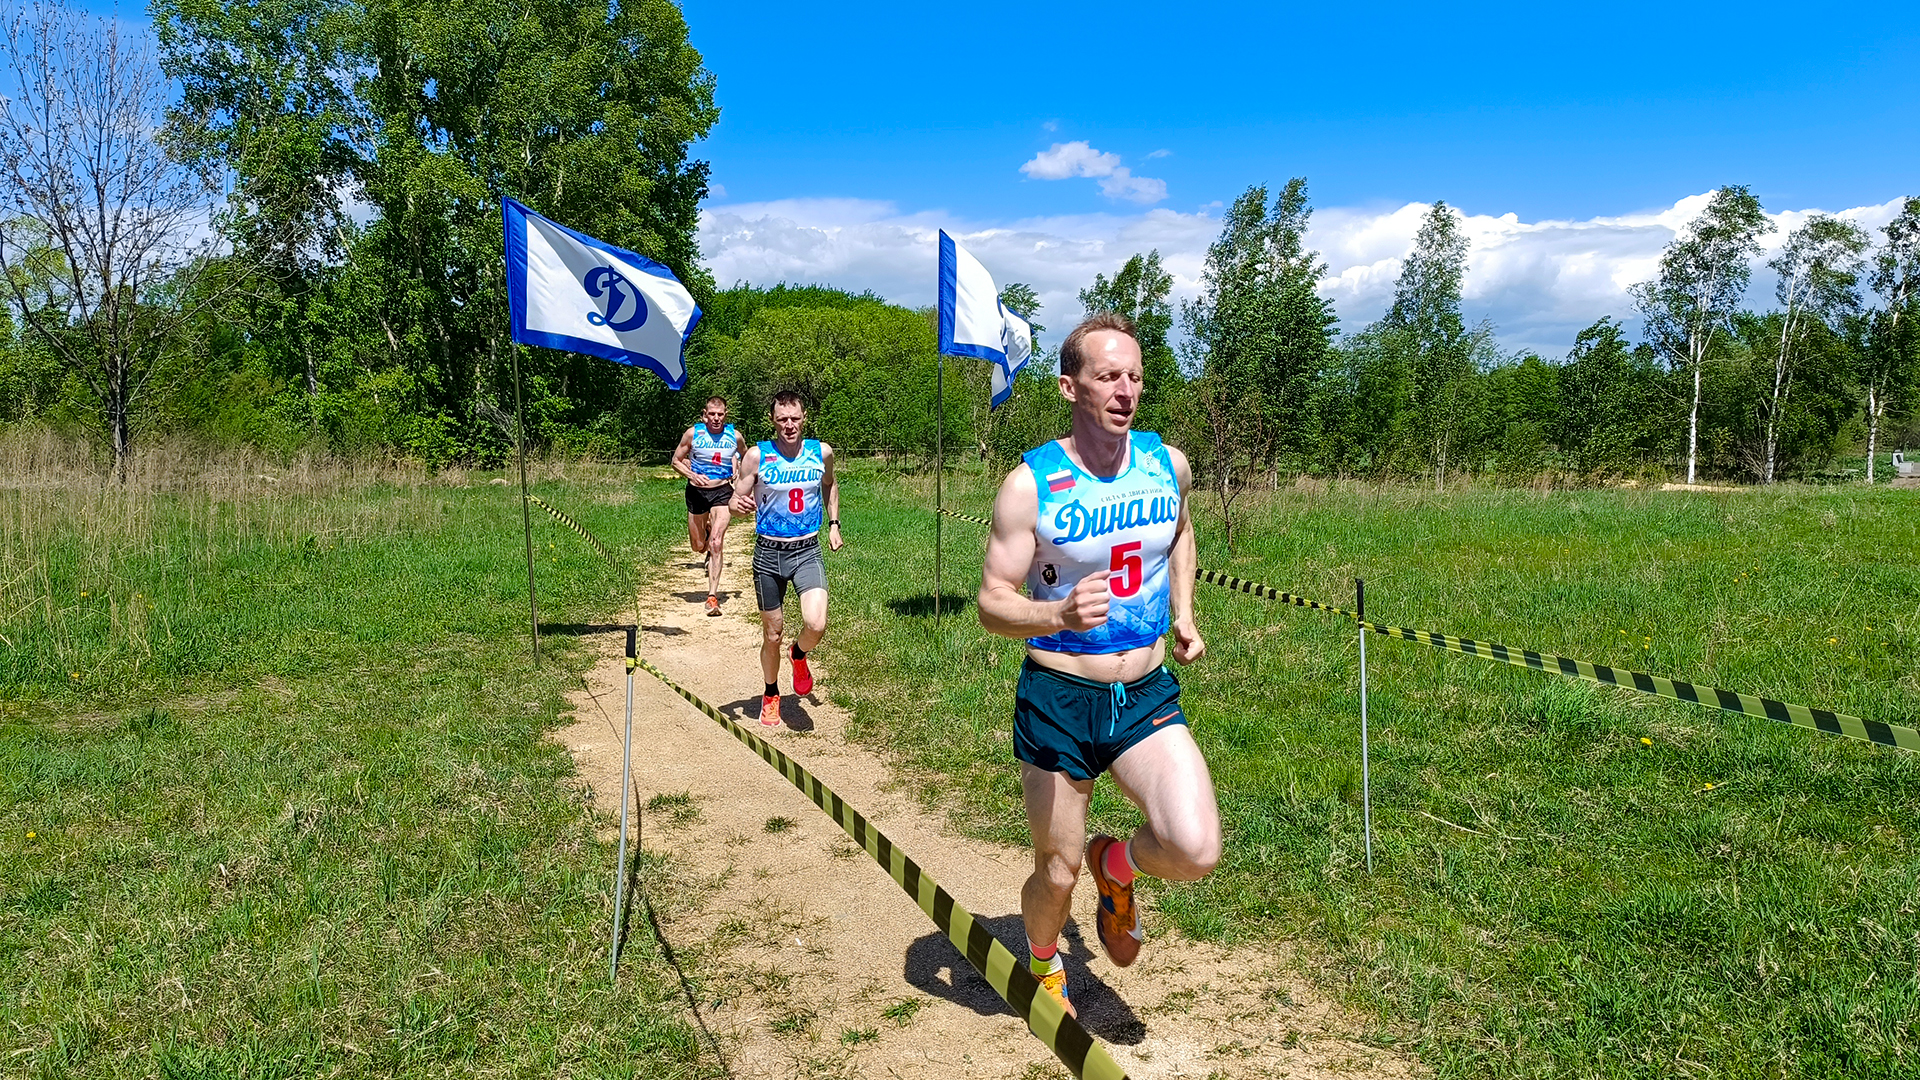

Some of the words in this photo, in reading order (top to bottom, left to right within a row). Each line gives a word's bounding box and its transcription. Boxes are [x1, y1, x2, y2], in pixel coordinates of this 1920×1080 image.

[788, 487, 805, 513] 8
[1052, 495, 1177, 545] Динамо
[1108, 540, 1142, 598] 5
